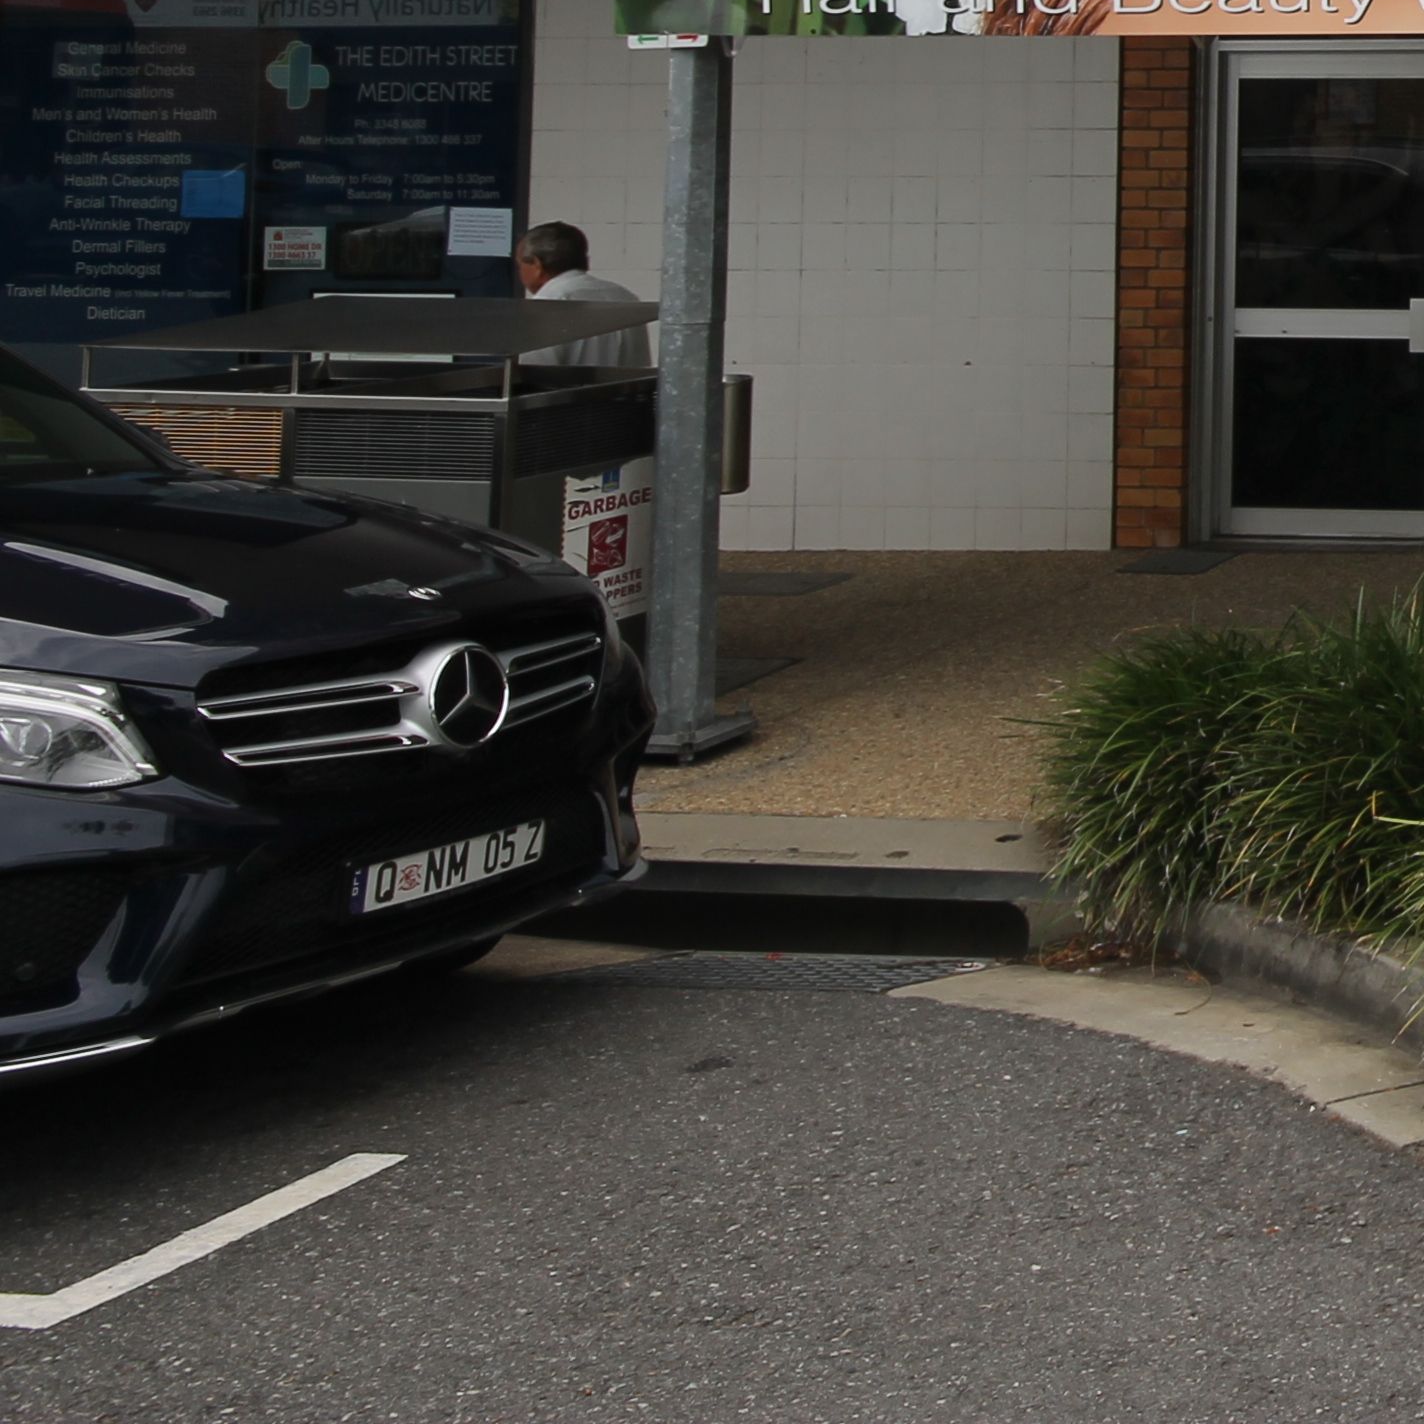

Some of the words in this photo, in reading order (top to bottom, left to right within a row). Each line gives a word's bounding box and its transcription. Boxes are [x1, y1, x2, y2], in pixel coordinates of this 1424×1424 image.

[68, 42, 121, 56] General
[125, 41, 187, 55] Medicine
[335, 46, 374, 67] THE
[380, 46, 440, 66] EDITH
[446, 45, 518, 66] STREET
[57, 63, 87, 77] Skin
[92, 63, 141, 77] Cancer
[144, 63, 196, 76] Checks
[76, 86, 175, 99] Immunisations
[357, 81, 493, 103] MEDICENTRE
[32, 107, 73, 121] Men's
[76, 107, 102, 121] and
[106, 107, 169, 121] Women's
[172, 107, 218, 121] Health
[65, 129, 134, 143] Children's
[137, 129, 182, 143] Health
[53, 152, 98, 165] Health
[101, 152, 193, 166] Assessments
[64, 174, 108, 187] Health
[111, 173, 180, 189] Checkups
[305, 174, 346, 187] Monday
[350, 174, 360, 185] to
[362, 174, 393, 187] Friday
[442, 174, 454, 185] to
[346, 189, 393, 202] Saturday
[442, 189, 454, 200] to
[64, 195, 106, 209] Facial
[109, 195, 178, 212] Threading
[49, 217, 131, 232] Anti-Wrinkle
[135, 217, 192, 234] Therapy
[72, 239, 122, 253] Dermal
[125, 239, 167, 253] Fillers
[75, 261, 162, 279] Psychologist
[4, 283, 47, 297] Travel
[50, 283, 112, 297] Medicine
[86, 305, 146, 320] Dietician
[567, 487, 653, 521] GARBAGE
[603, 568, 643, 589] WASTE
